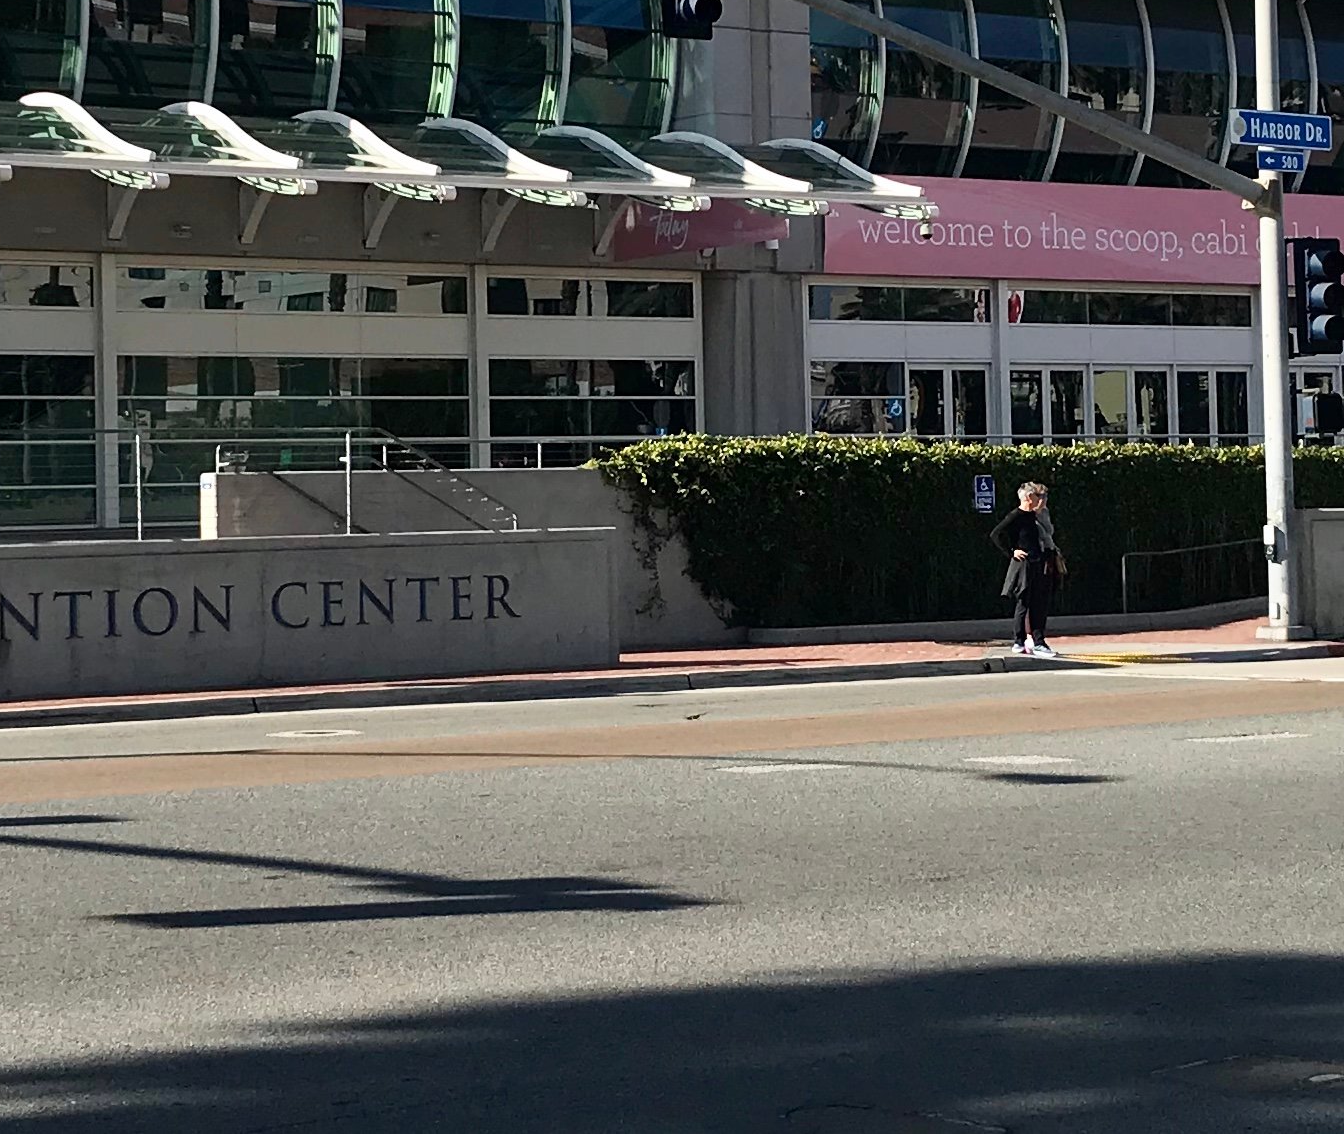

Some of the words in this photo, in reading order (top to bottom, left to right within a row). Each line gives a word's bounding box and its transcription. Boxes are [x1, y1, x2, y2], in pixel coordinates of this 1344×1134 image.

[1250, 118, 1301, 141] HARBOR
[1305, 122, 1327, 143] DR.
[1281, 156, 1298, 169] 500
[858, 218, 994, 247] welcome
[1002, 220, 1031, 248] to
[1040, 213, 1087, 250] the
[1095, 227, 1184, 262] scoop,
[1191, 219, 1248, 255] cabi
[271, 573, 523, 630] CENTER
